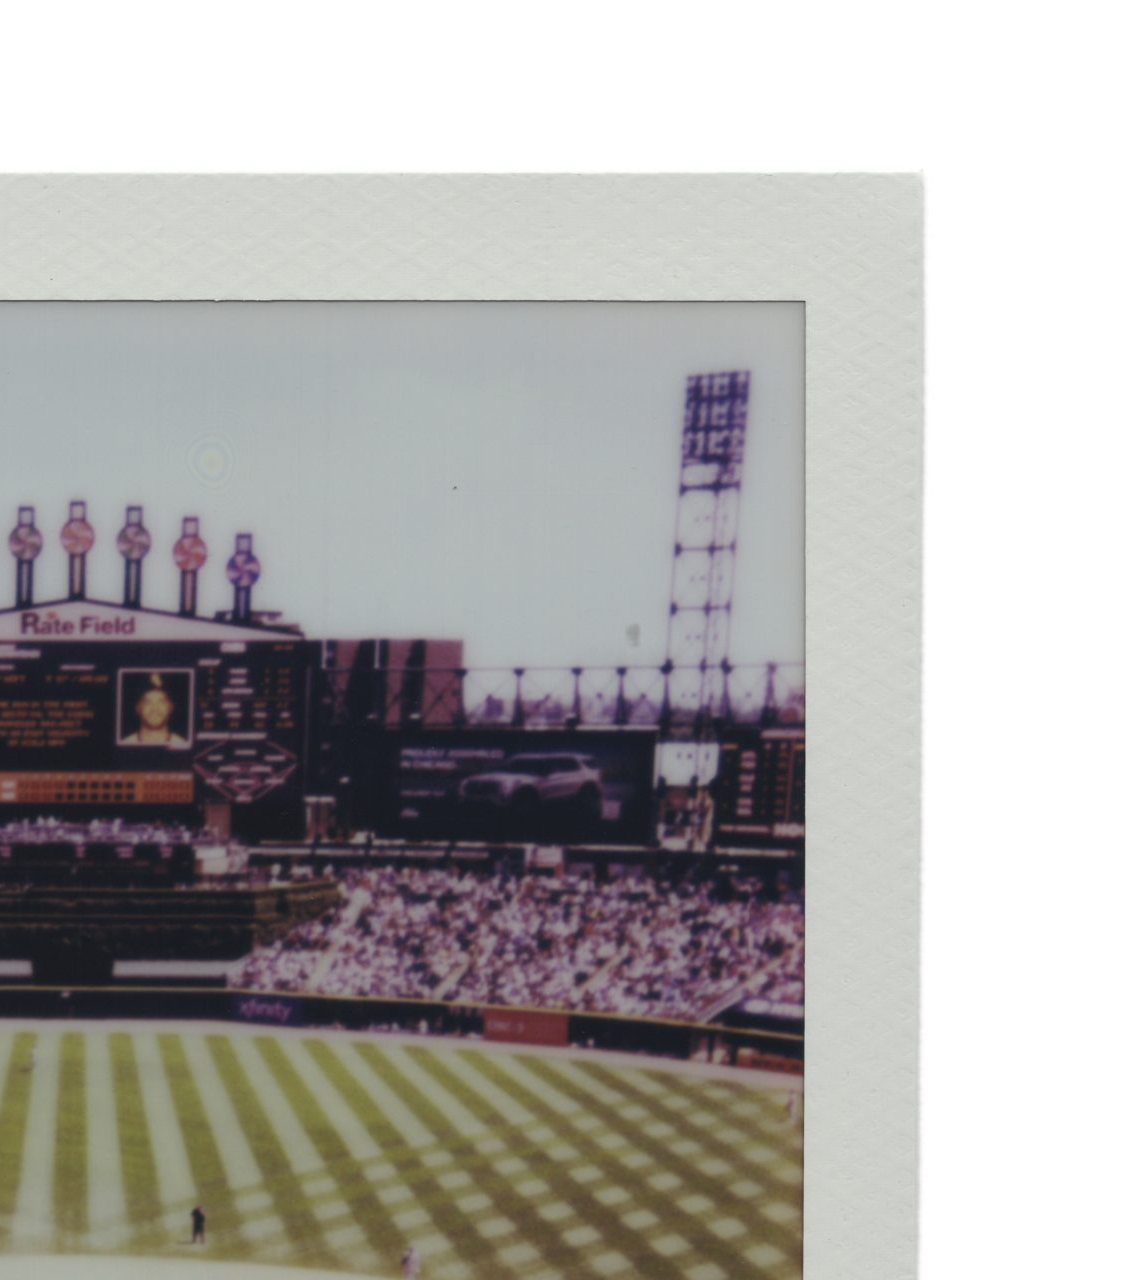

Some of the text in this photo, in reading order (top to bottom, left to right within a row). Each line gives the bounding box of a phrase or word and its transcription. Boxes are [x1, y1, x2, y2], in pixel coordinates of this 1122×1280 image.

[20, 612, 135, 635] Rate Field
[238, 998, 293, 1022] xfinity
